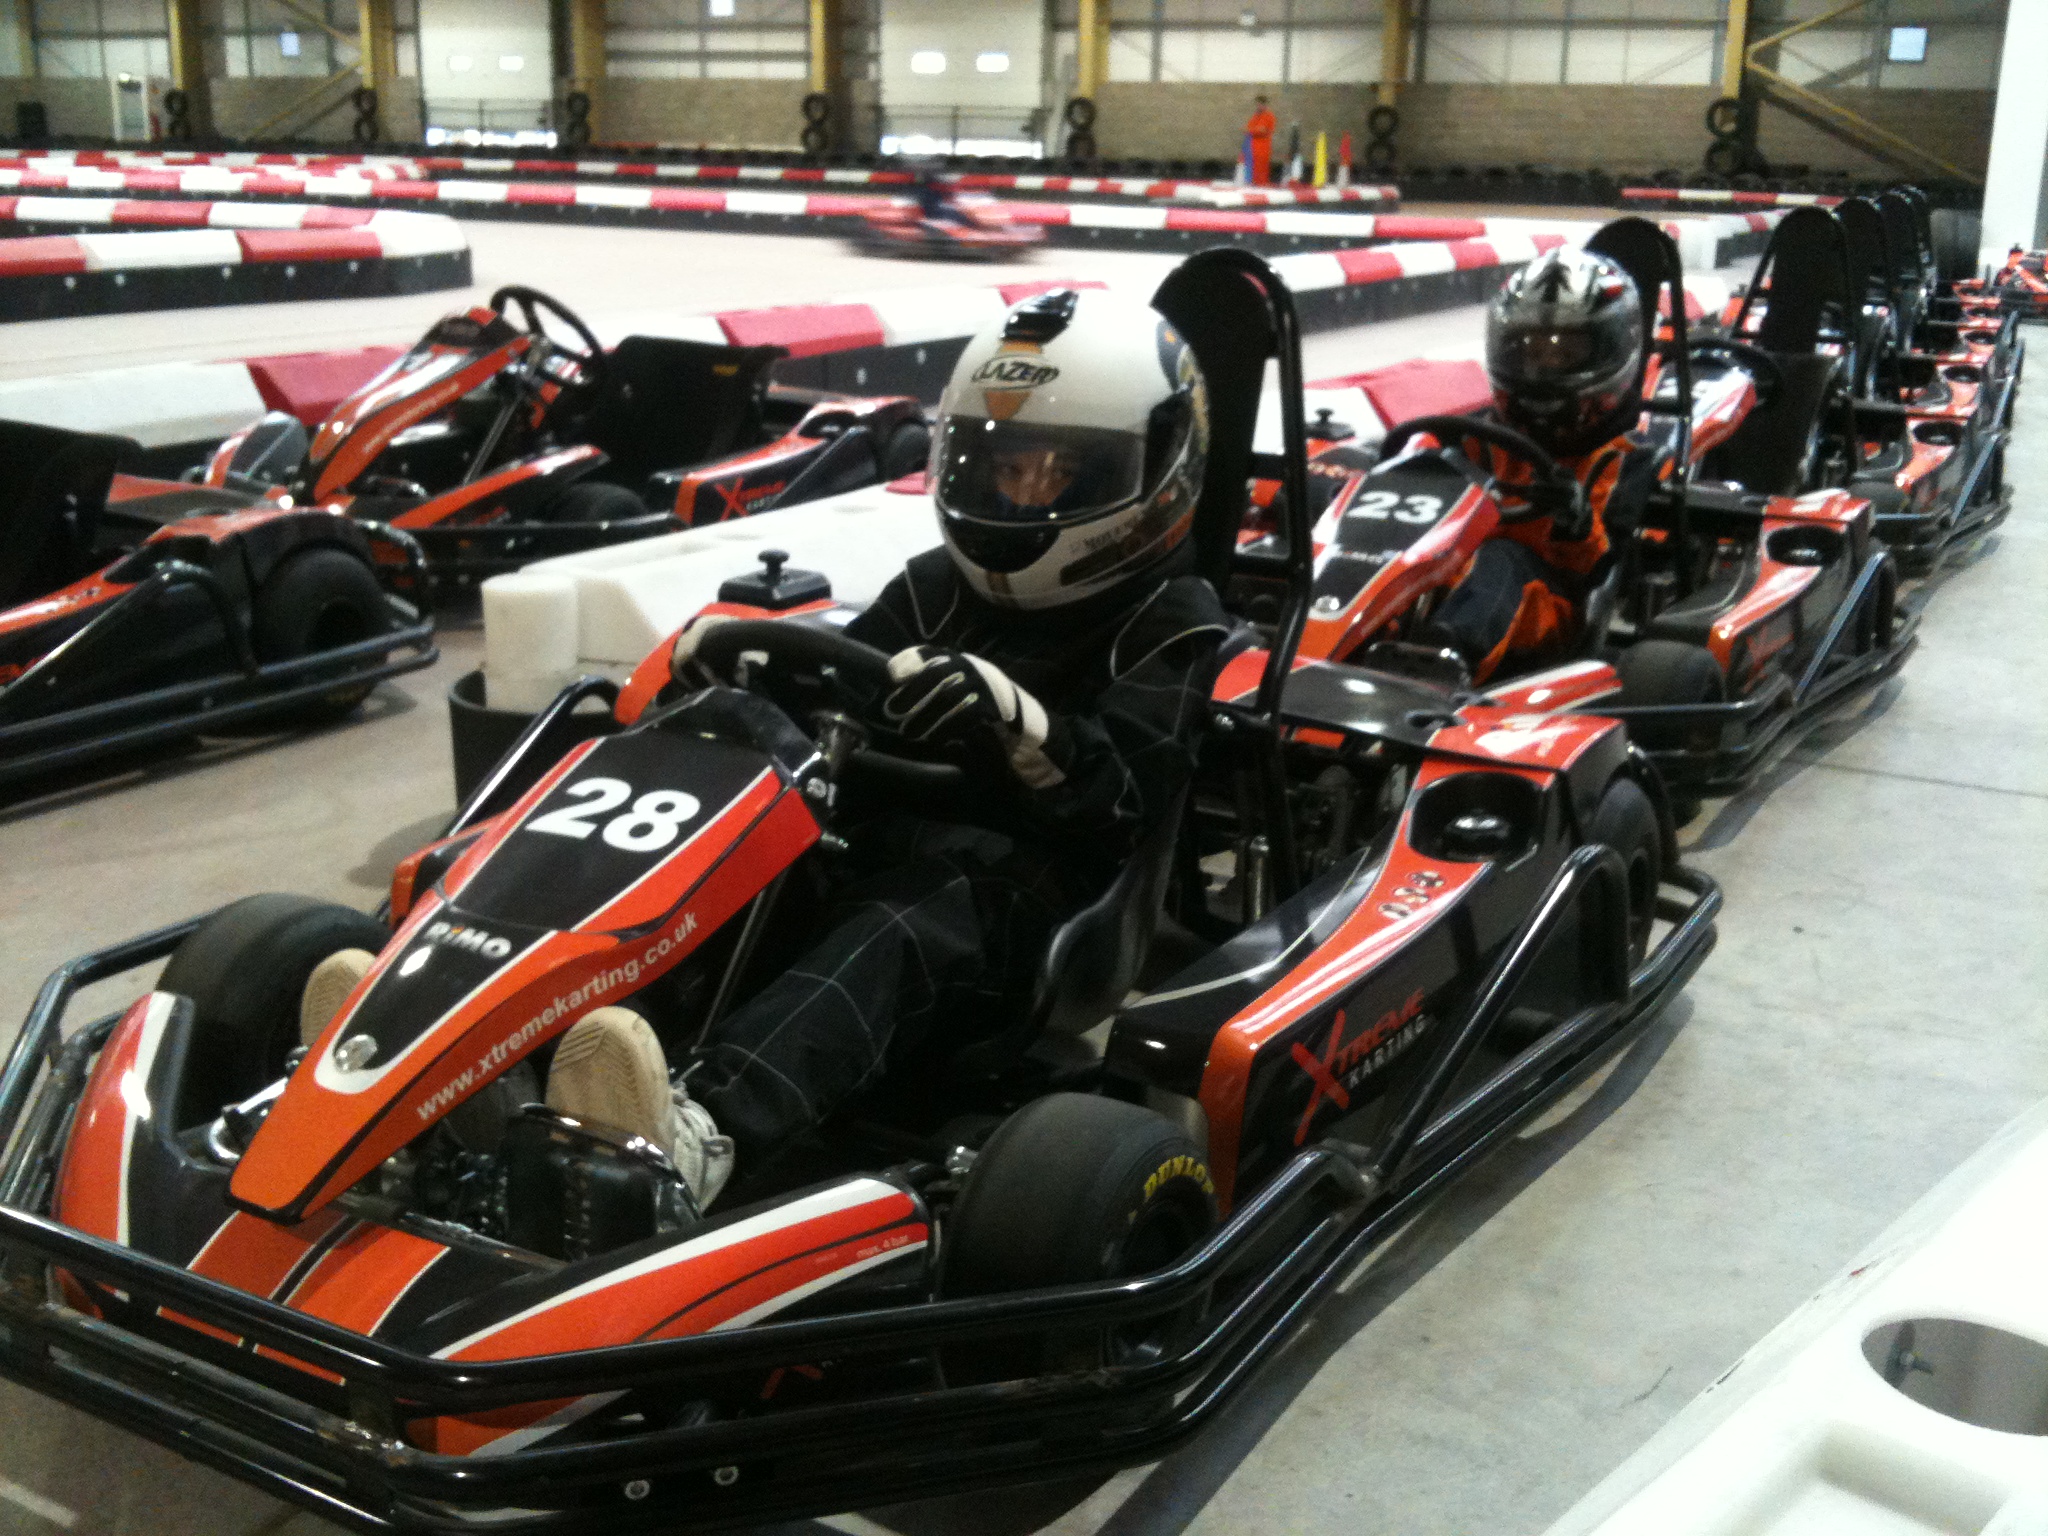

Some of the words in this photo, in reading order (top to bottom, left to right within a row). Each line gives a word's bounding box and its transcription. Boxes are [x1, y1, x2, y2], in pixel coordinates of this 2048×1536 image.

[1347, 490, 1444, 524] 23
[525, 776, 701, 853] 28
[416, 911, 699, 1121] www.xtremekarting.co.uk
[1348, 1013, 1426, 1090] KARTING
[1142, 1154, 1215, 1204] DUNLOP
